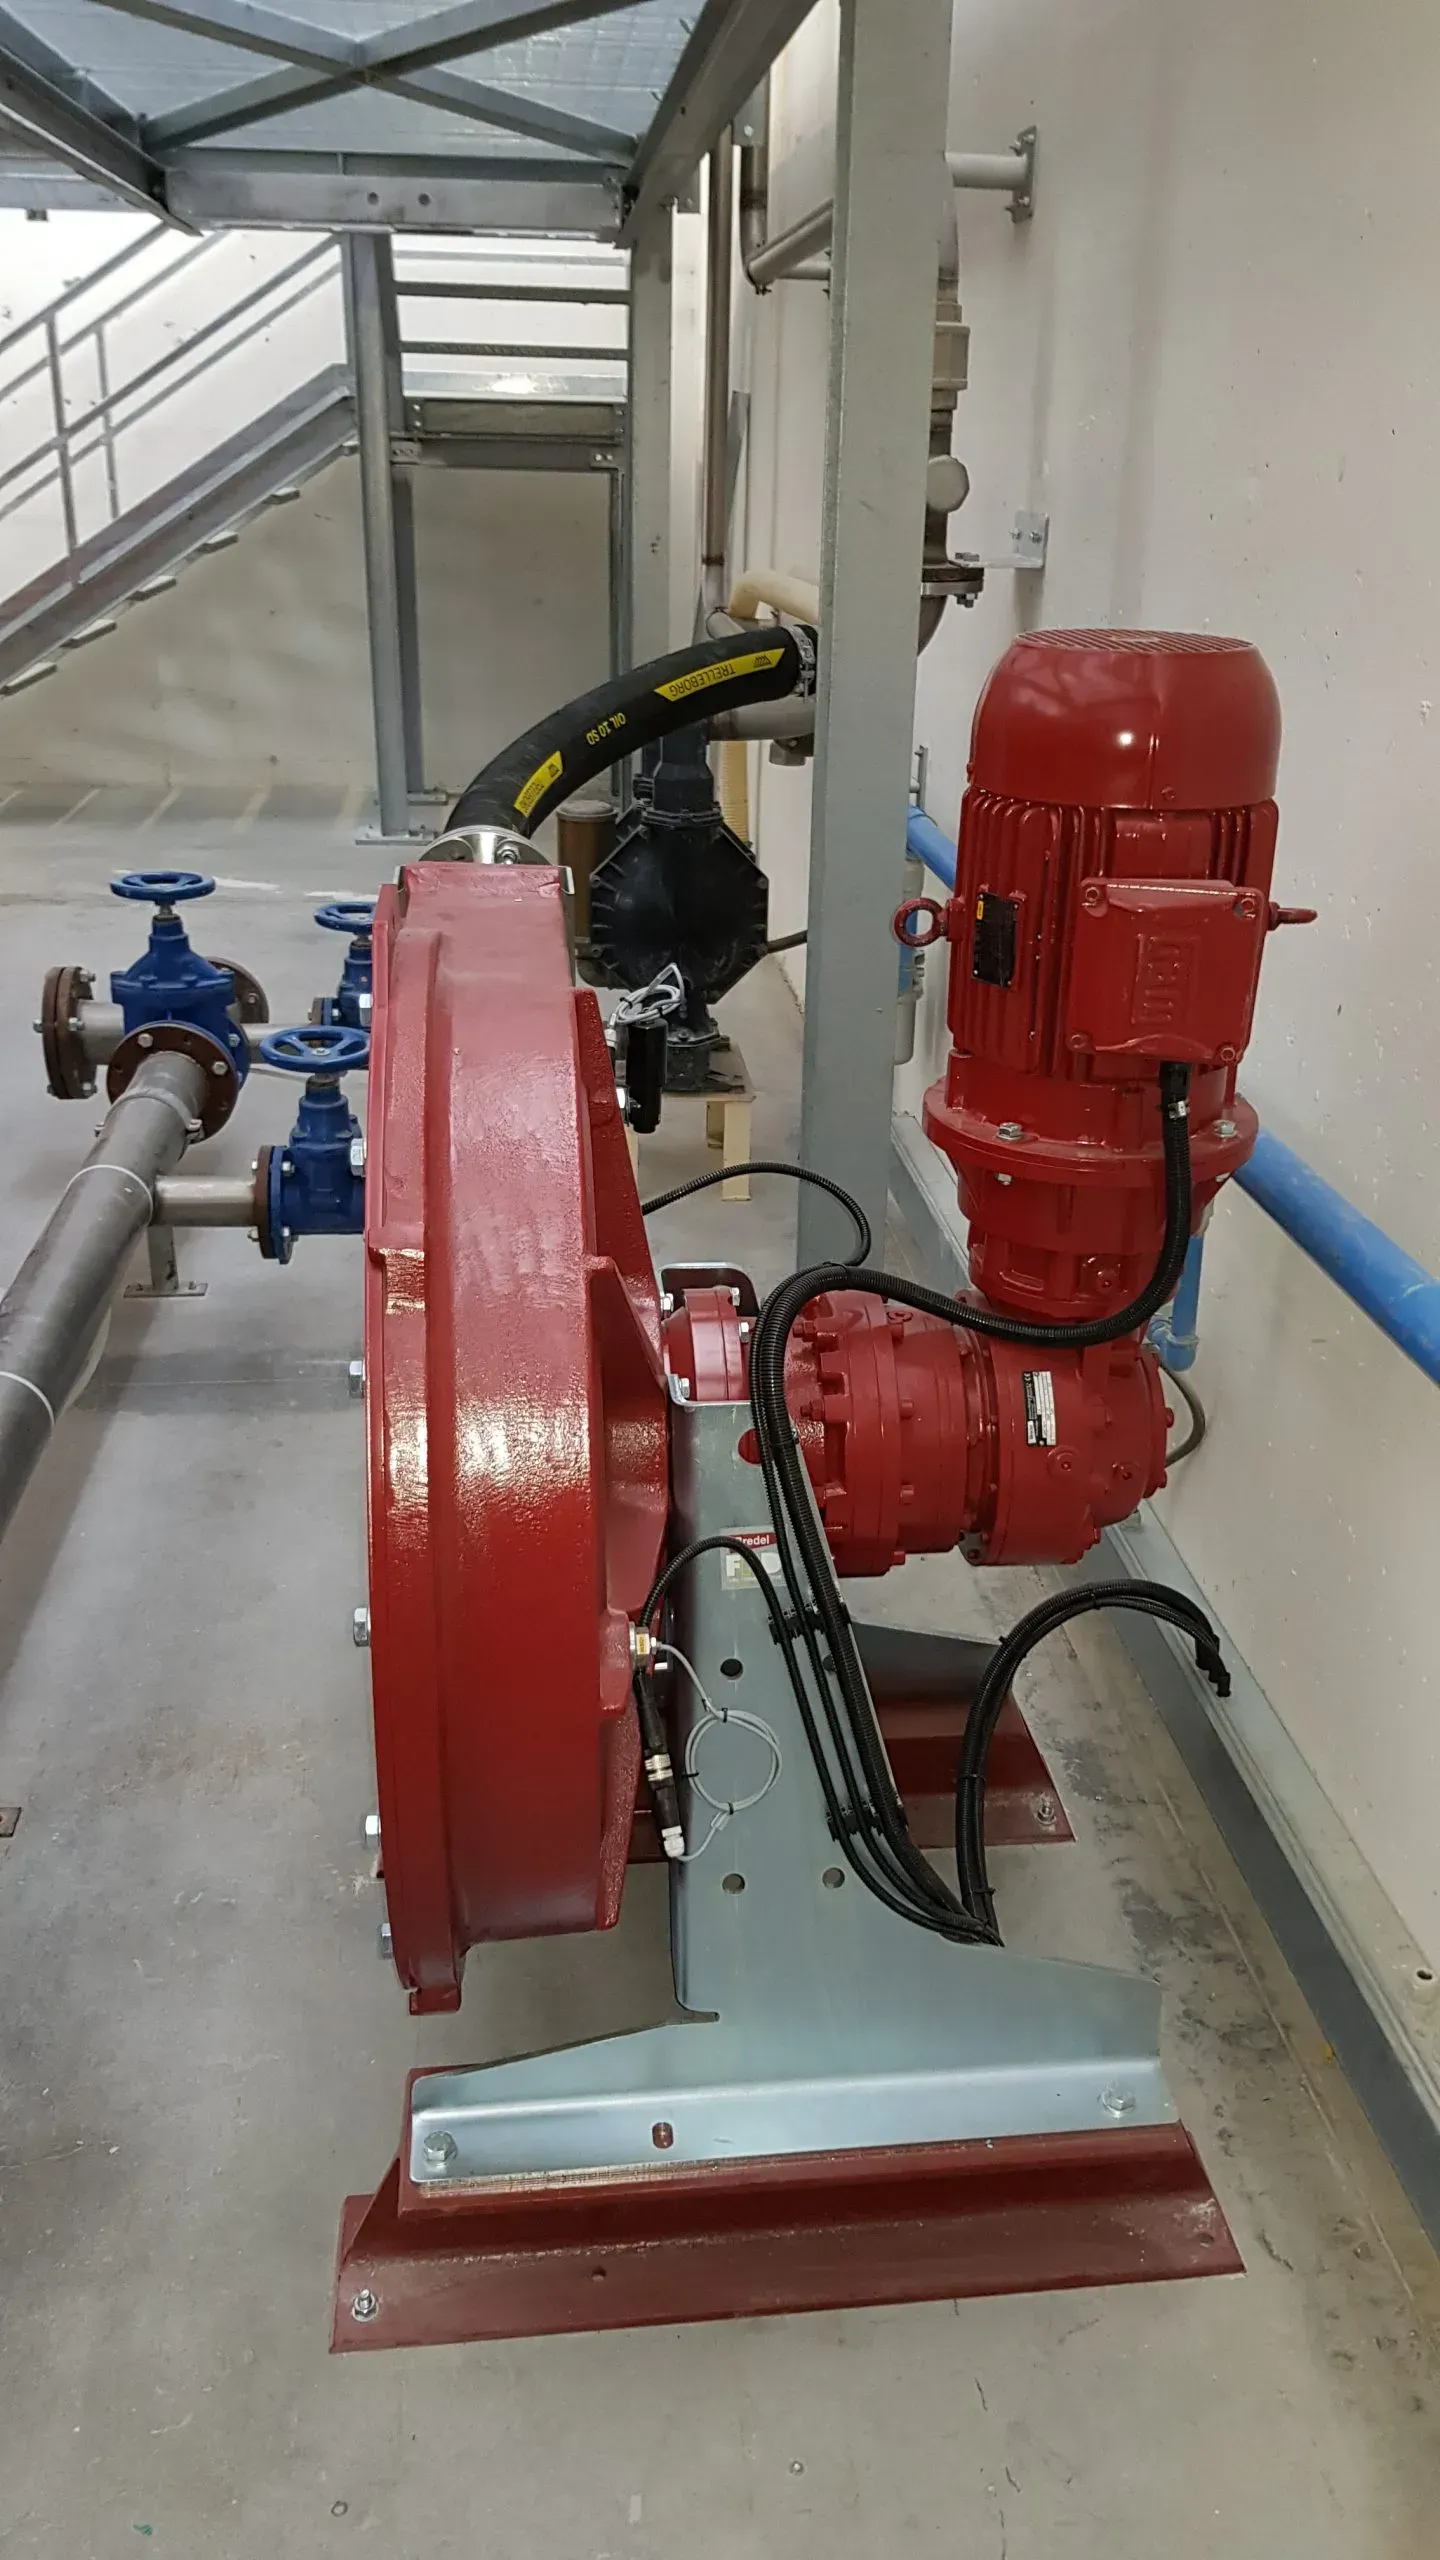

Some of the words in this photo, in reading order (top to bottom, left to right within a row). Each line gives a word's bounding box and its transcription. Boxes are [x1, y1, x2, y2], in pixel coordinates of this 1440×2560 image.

[669, 663, 736, 697] TRELLEBORG
[609, 712, 626, 729] OIL
[586, 729, 600, 745] SD
[598, 721, 611, 737] 10
